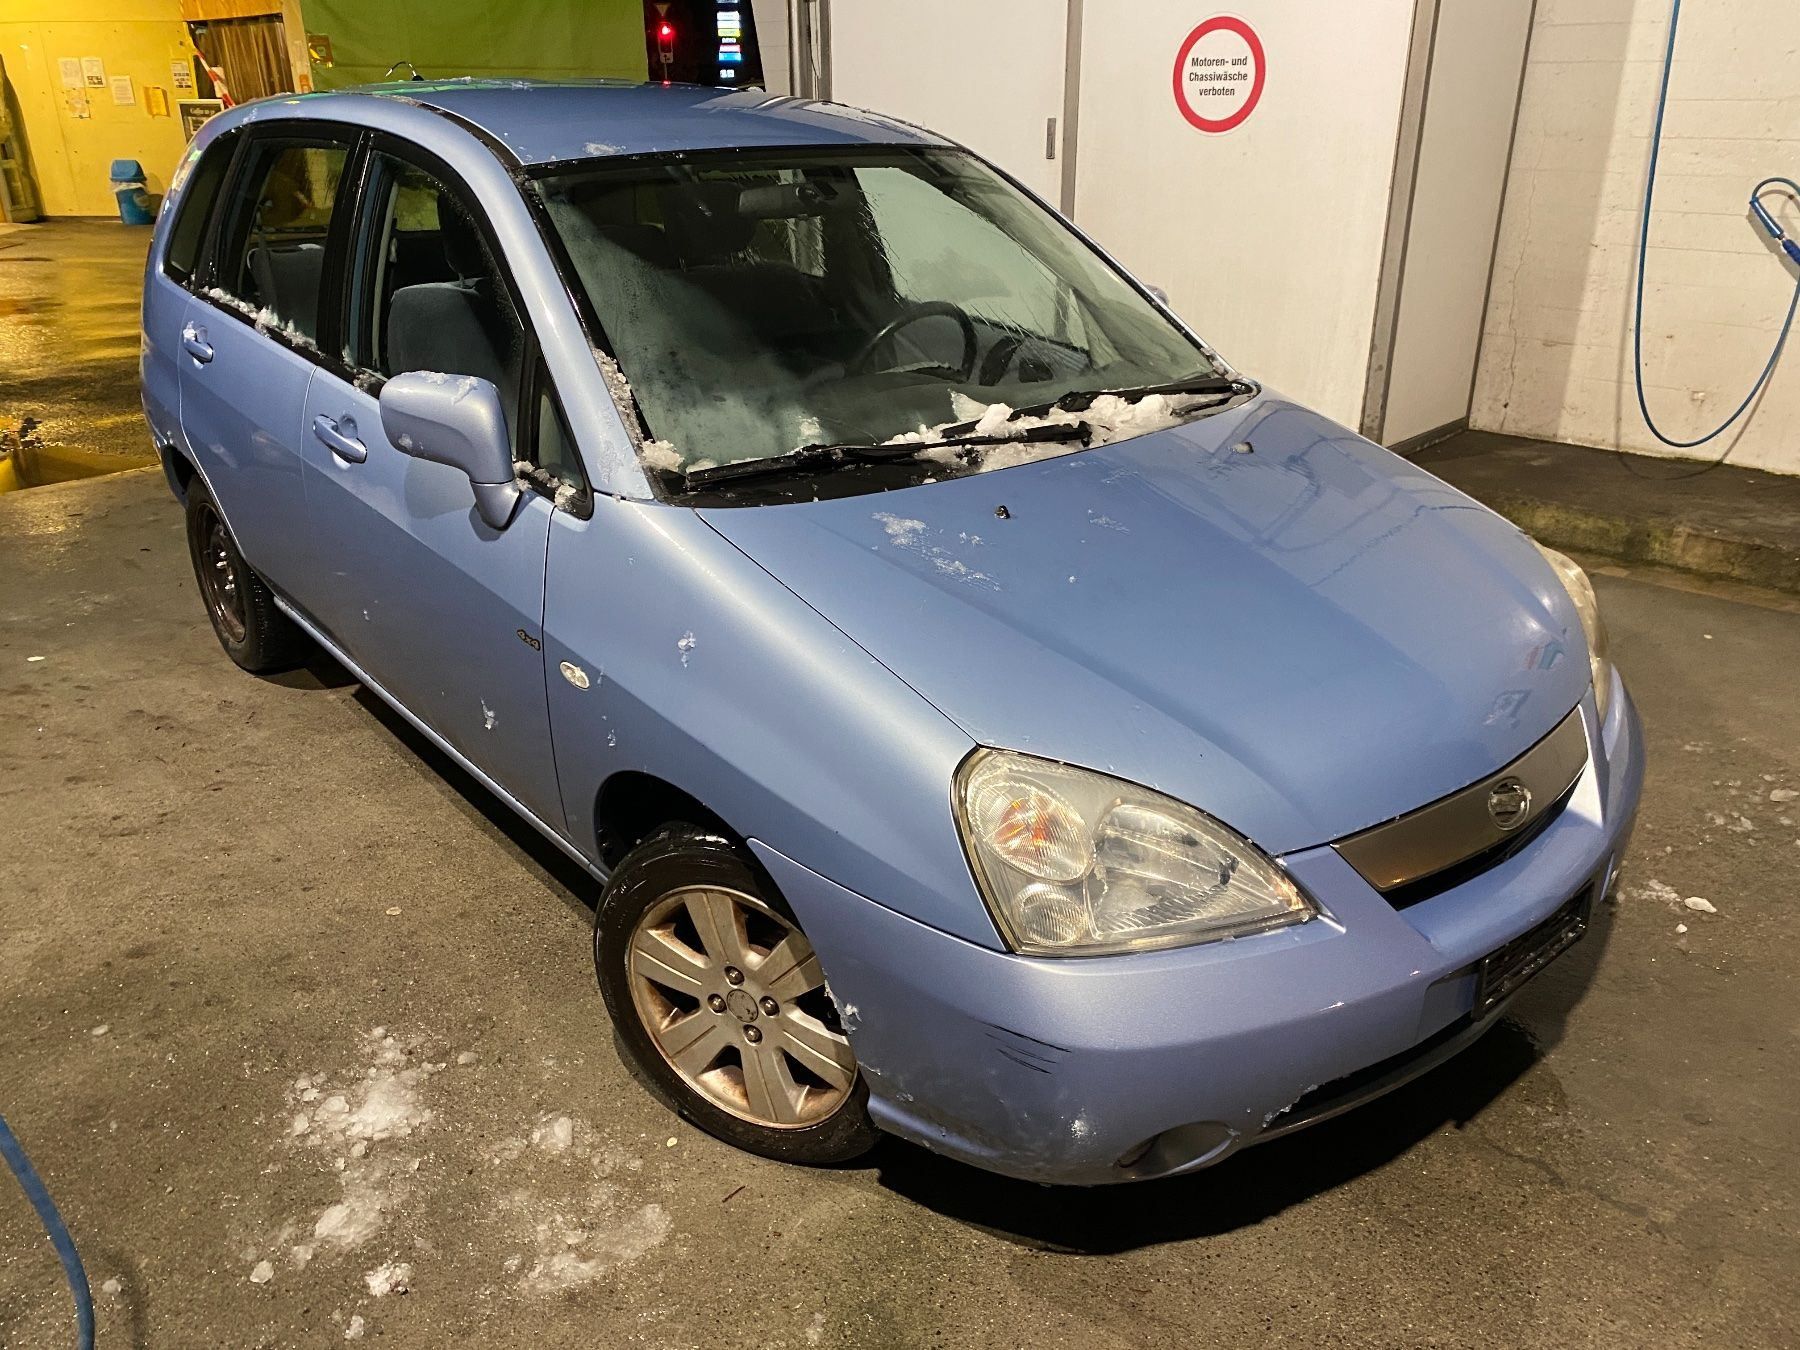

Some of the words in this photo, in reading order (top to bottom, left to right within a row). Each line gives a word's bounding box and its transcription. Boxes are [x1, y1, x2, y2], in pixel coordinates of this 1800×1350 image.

[1191, 57, 1229, 66] Motoren-
[1231, 56, 1247, 66] und
[1189, 71, 1248, 81] Chassiwäsche
[1199, 86, 1235, 95] verboten
